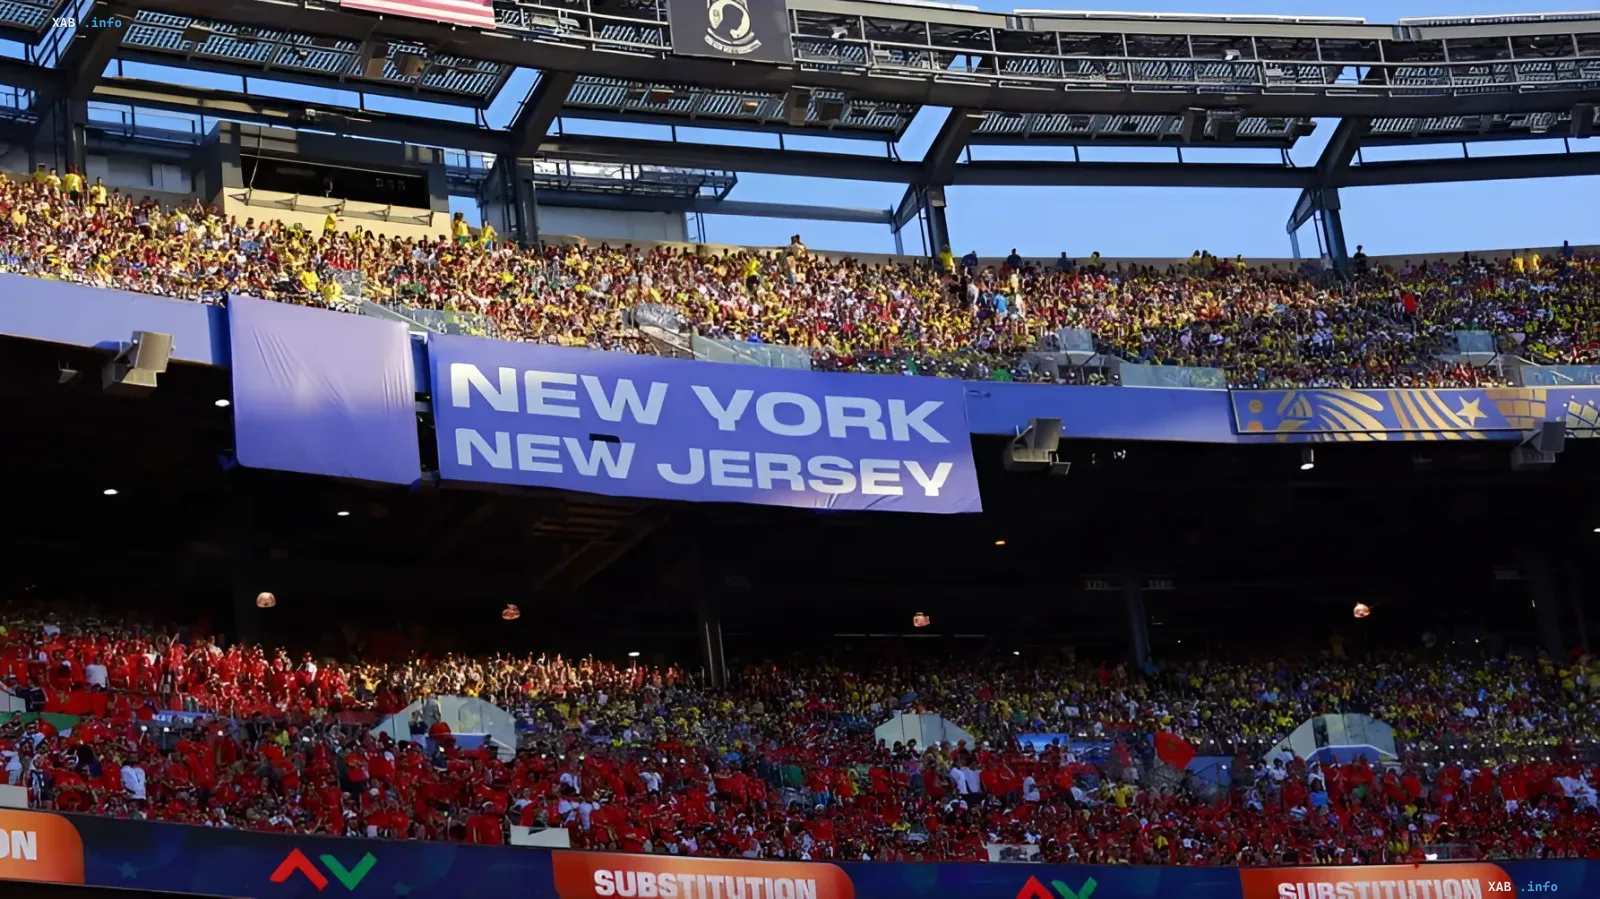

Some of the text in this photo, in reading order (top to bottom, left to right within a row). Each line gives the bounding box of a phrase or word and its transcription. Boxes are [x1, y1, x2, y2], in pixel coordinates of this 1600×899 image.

[450, 362, 951, 443] NEW YORK
[455, 427, 954, 497] NEW JERSEY
[594, 869, 817, 899] SUBSTITUTION
[1277, 879, 1483, 899] SUBSTITUTION
